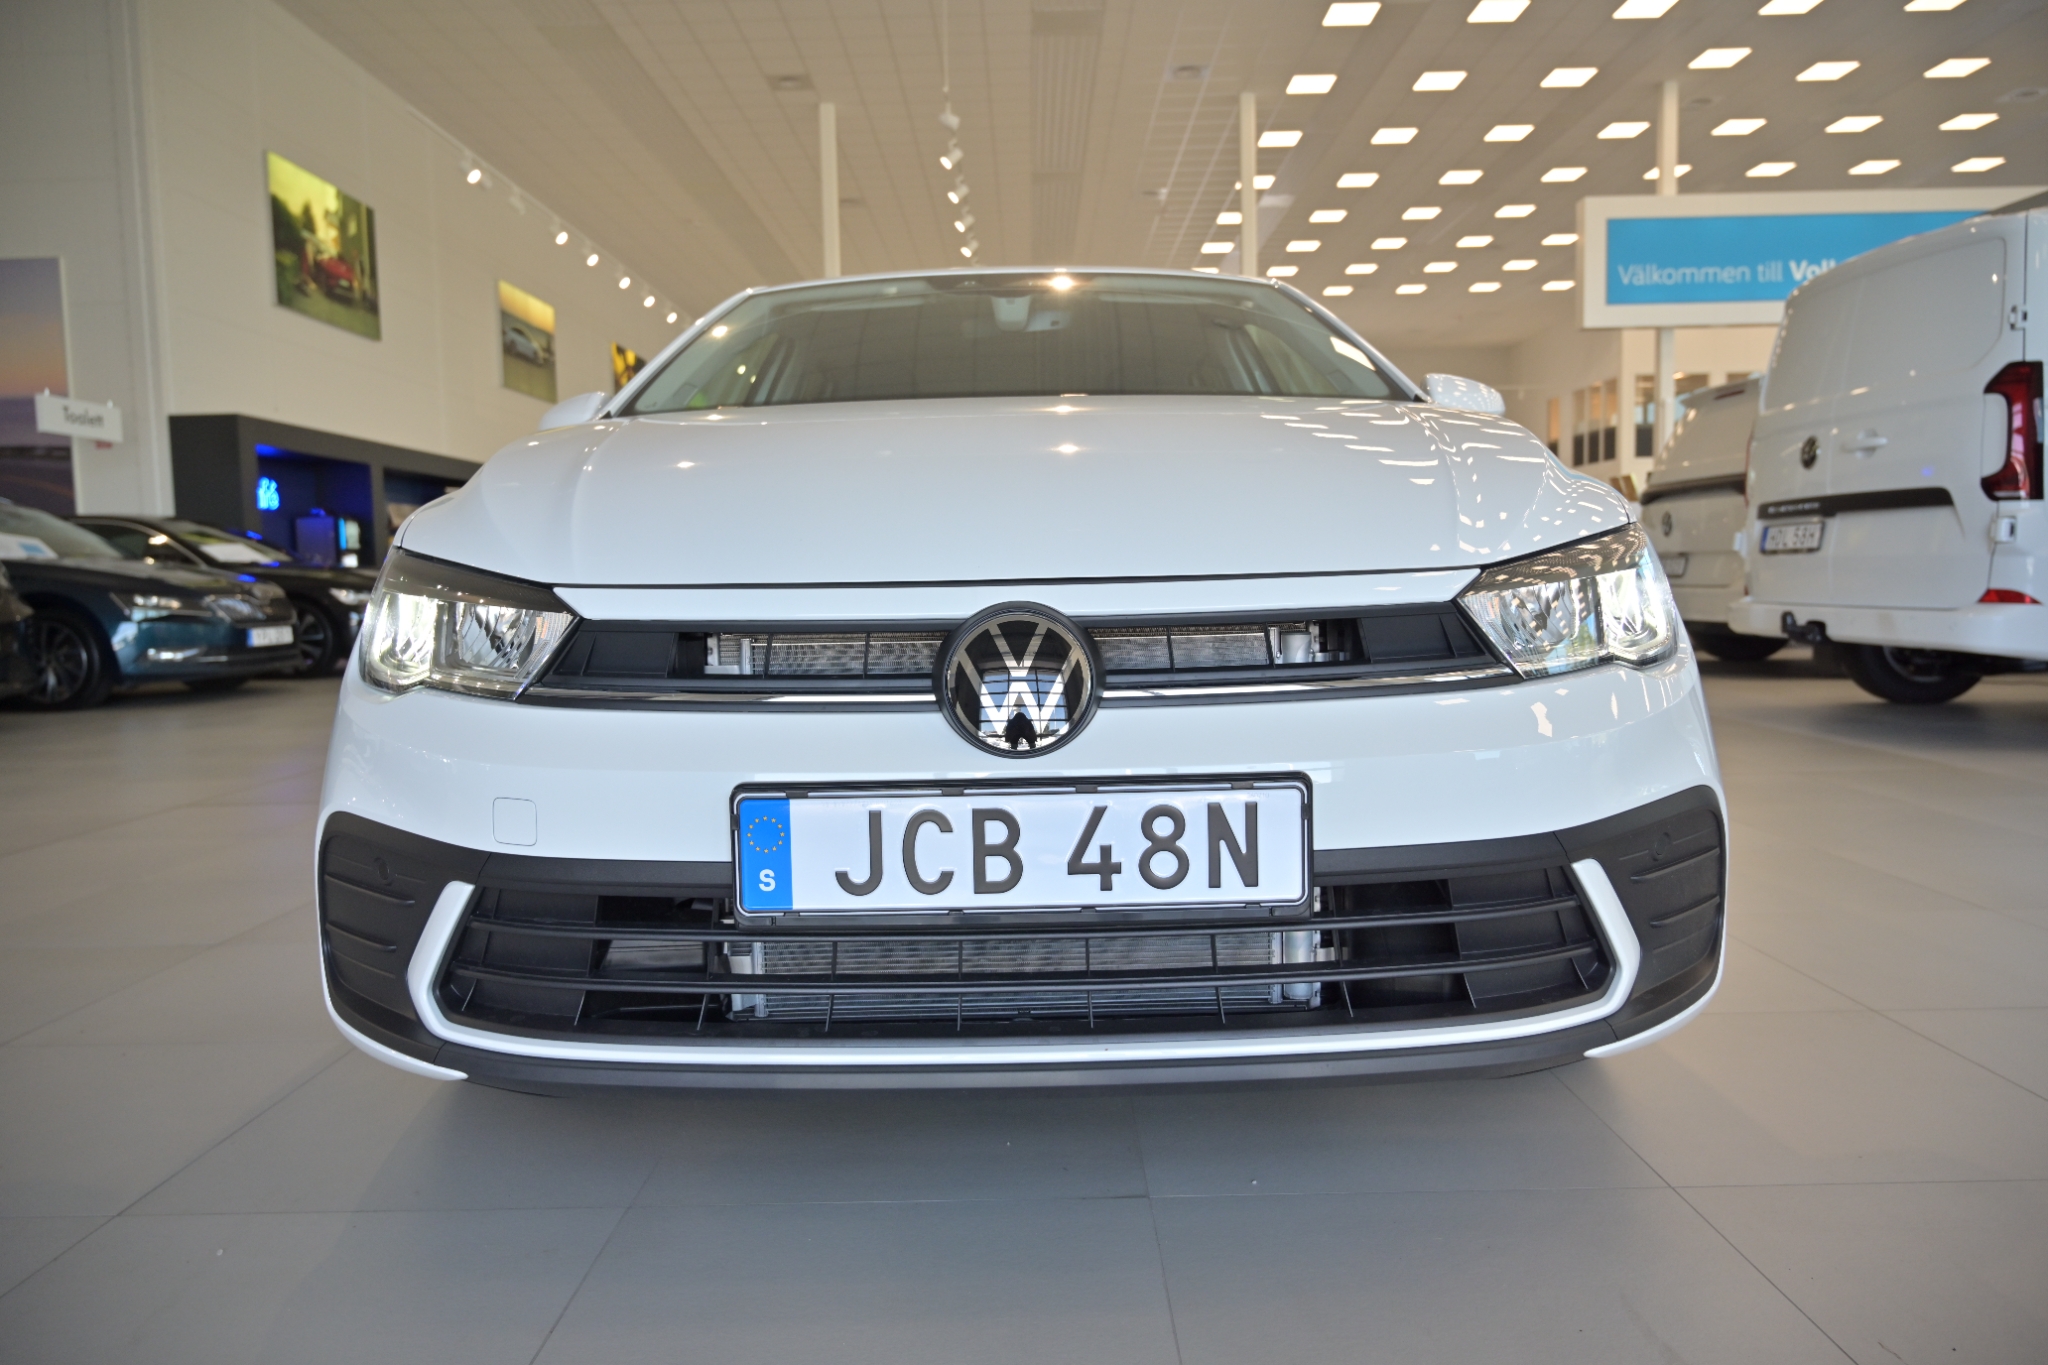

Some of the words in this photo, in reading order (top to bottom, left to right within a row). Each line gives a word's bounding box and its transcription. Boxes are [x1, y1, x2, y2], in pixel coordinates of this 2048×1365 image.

[1617, 262, 1751, 286] Välkommen
[1757, 260, 1783, 283] till
[835, 807, 1024, 896] JCB
[1067, 801, 1259, 891] 48N
[758, 868, 776, 892] S
